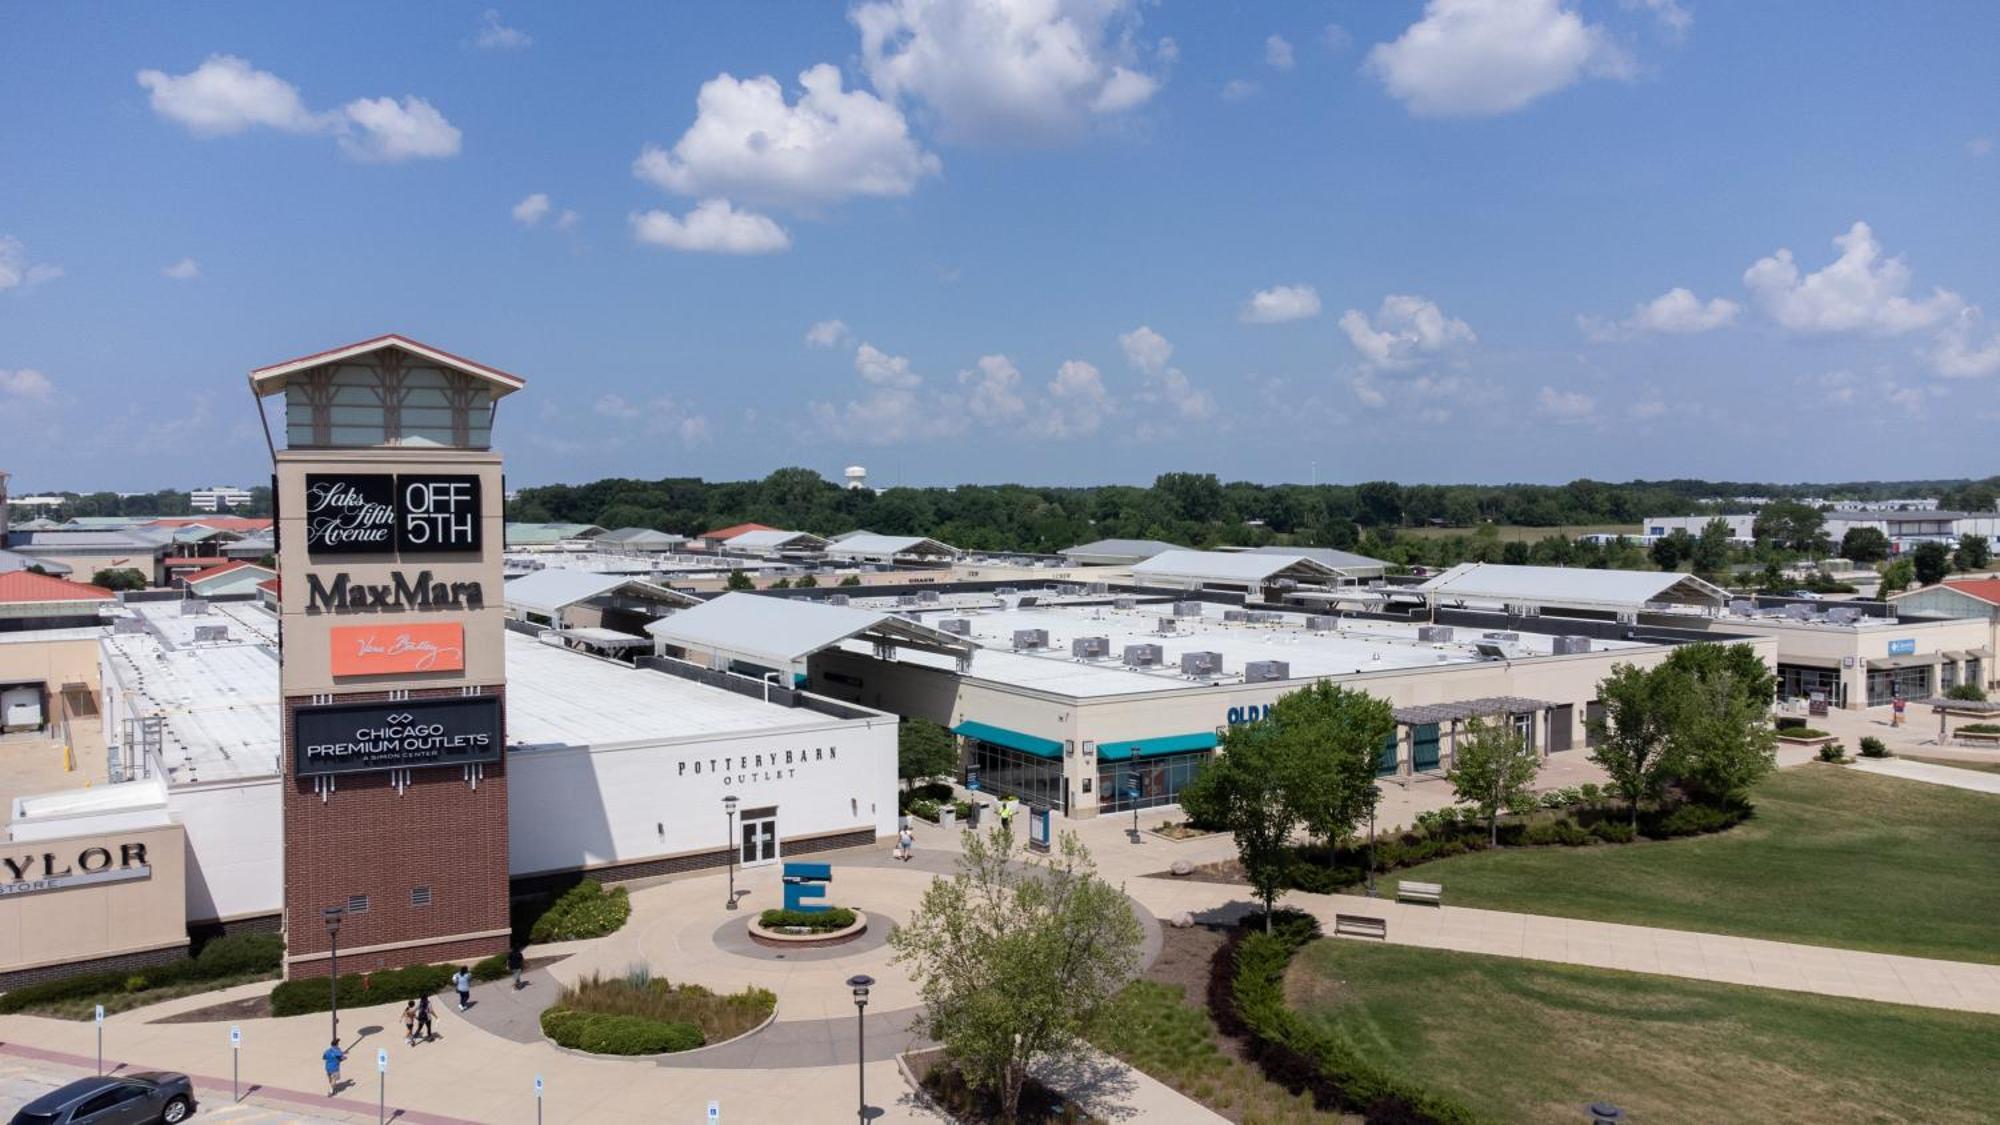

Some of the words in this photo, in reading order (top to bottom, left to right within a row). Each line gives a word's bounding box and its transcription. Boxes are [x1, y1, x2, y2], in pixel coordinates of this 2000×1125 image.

[306, 482, 365, 515] Saks
[406, 483, 471, 513] OFF
[307, 517, 389, 546] Avenue
[407, 513, 472, 543] 5TH
[1227, 705, 1260, 724] OLD
[356, 724, 444, 741] CHICAGO
[307, 742, 399, 758] PREMIUM
[404, 733, 489, 750] OUTLETS
[402, 750, 438, 759] CENTER
[724, 769, 795, 785] OUTLET
